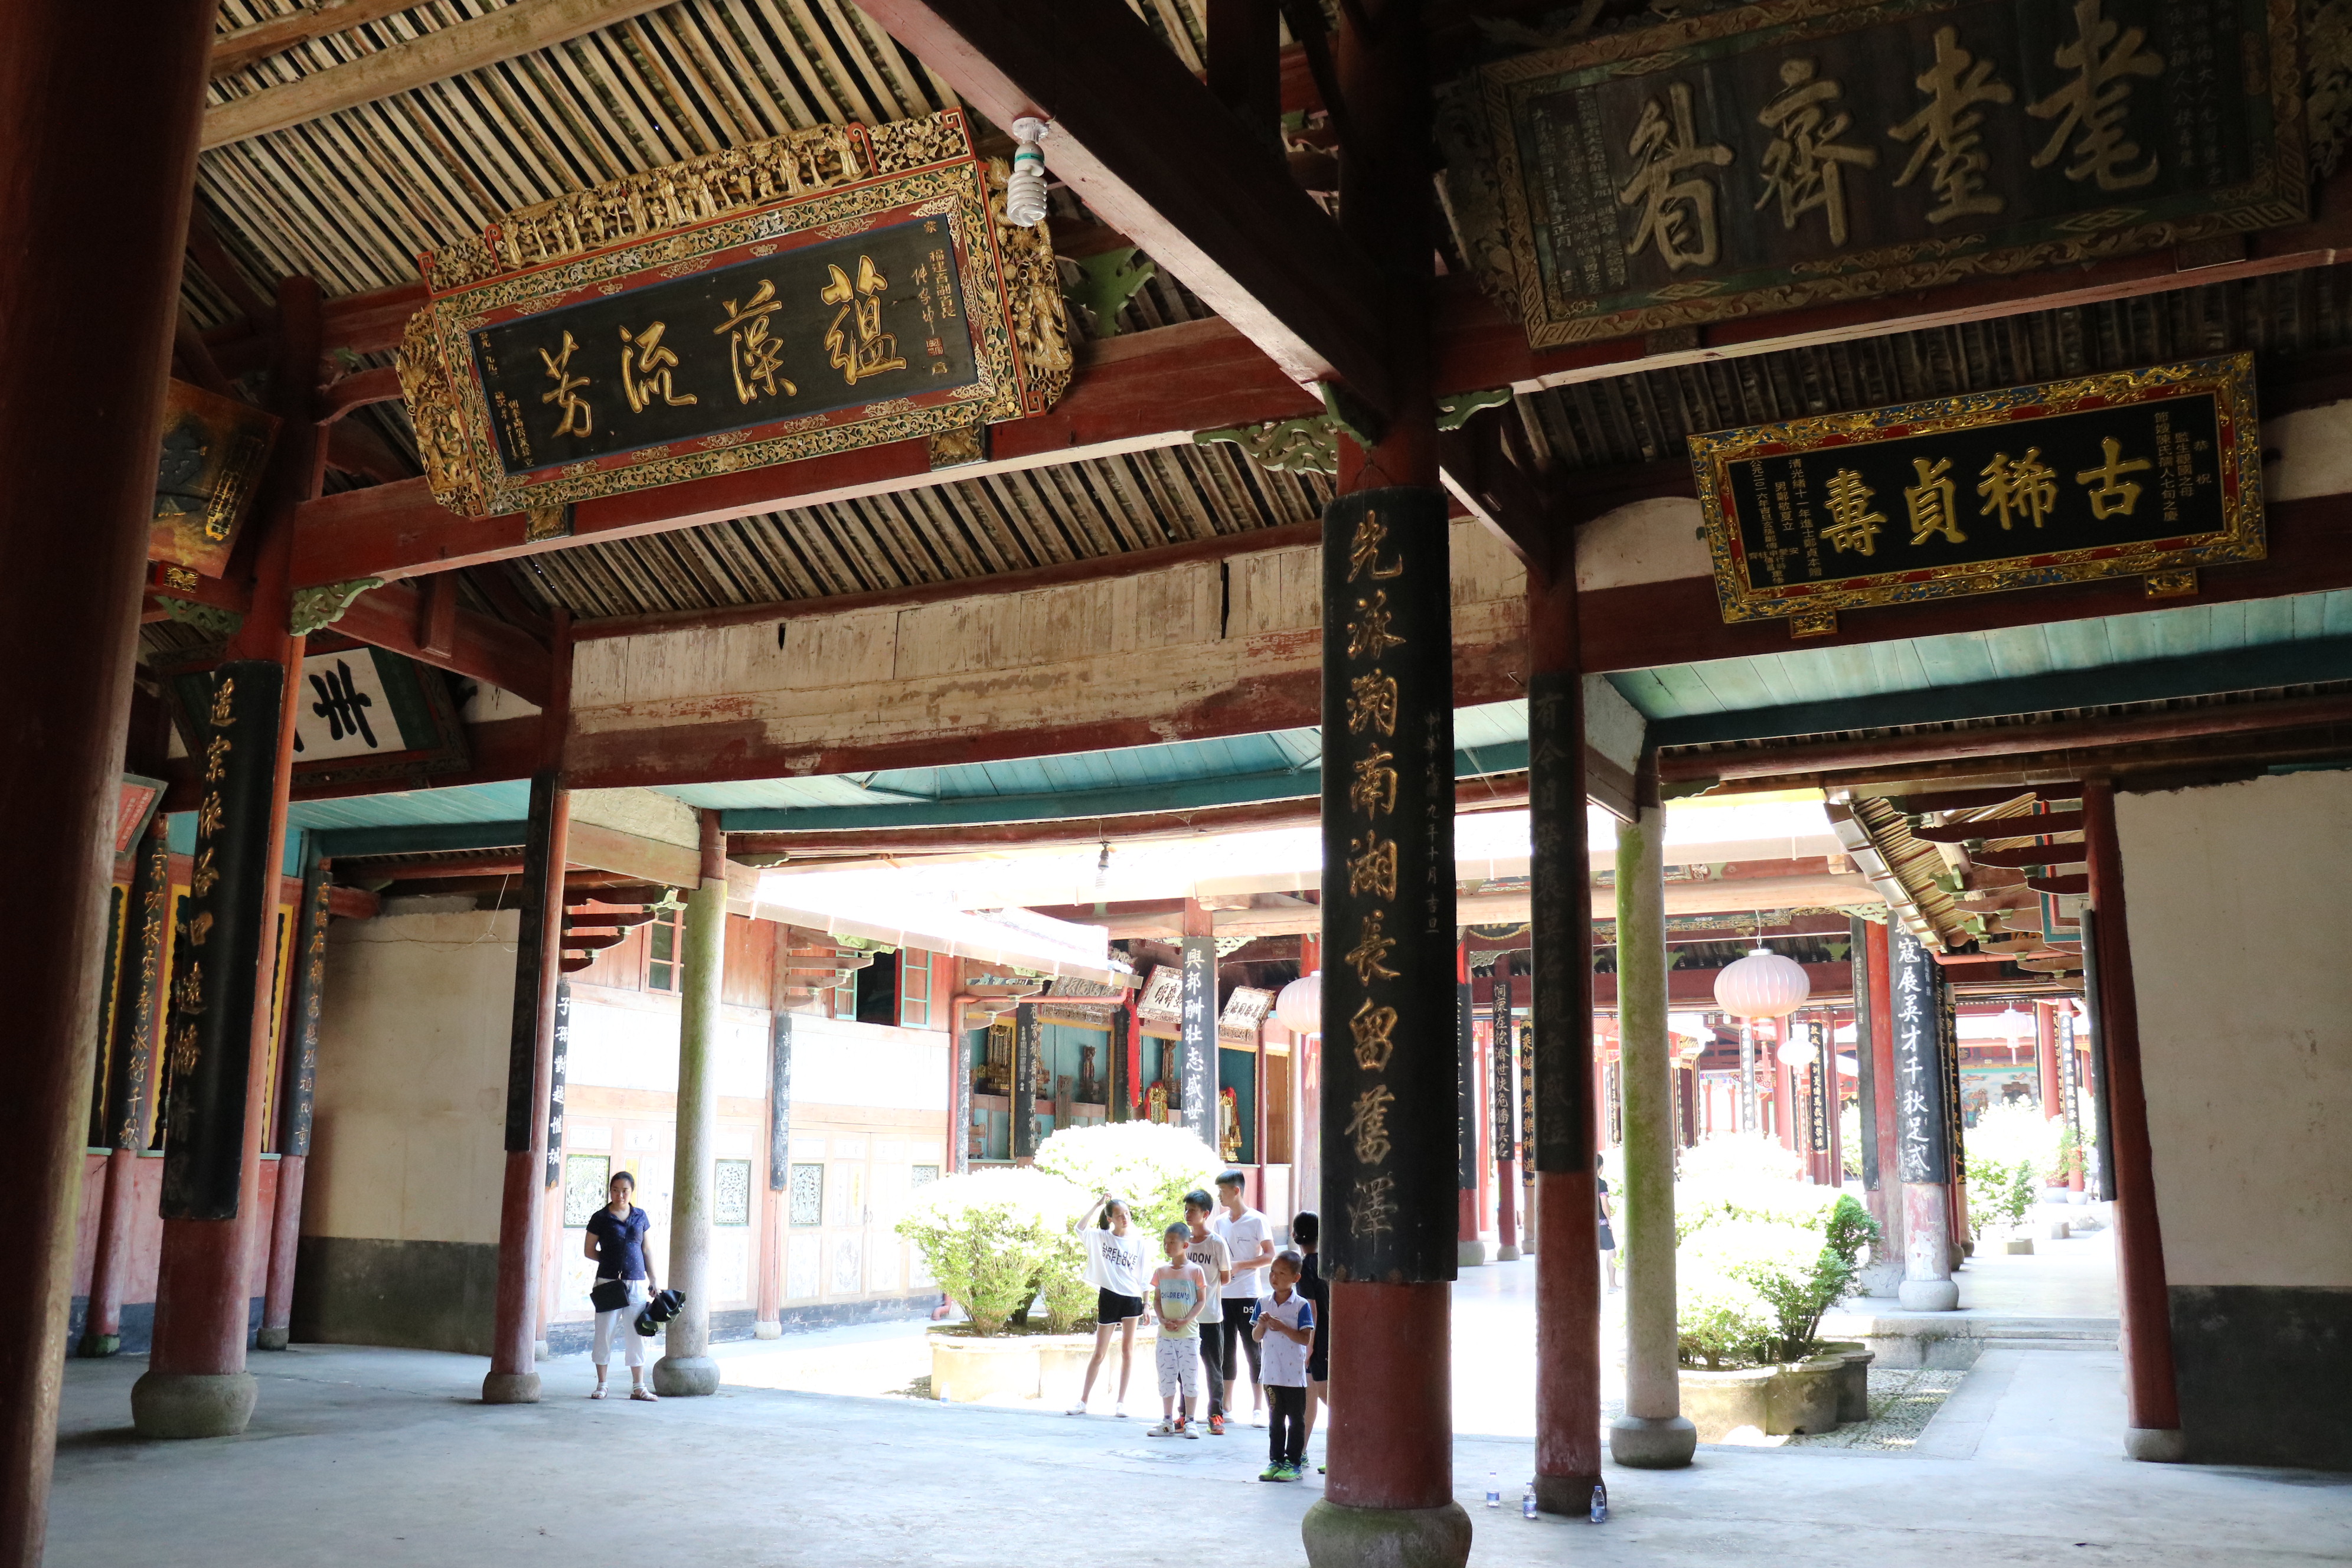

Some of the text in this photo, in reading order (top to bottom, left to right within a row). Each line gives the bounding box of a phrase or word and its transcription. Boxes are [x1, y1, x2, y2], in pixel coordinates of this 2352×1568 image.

[929, 249, 956, 318] 福建省副省長
[2174, 432, 2195, 496] 監生觀國之母
[2194, 440, 2212, 485] 恭祝
[1819, 436, 2151, 557] 古稀貞壽
